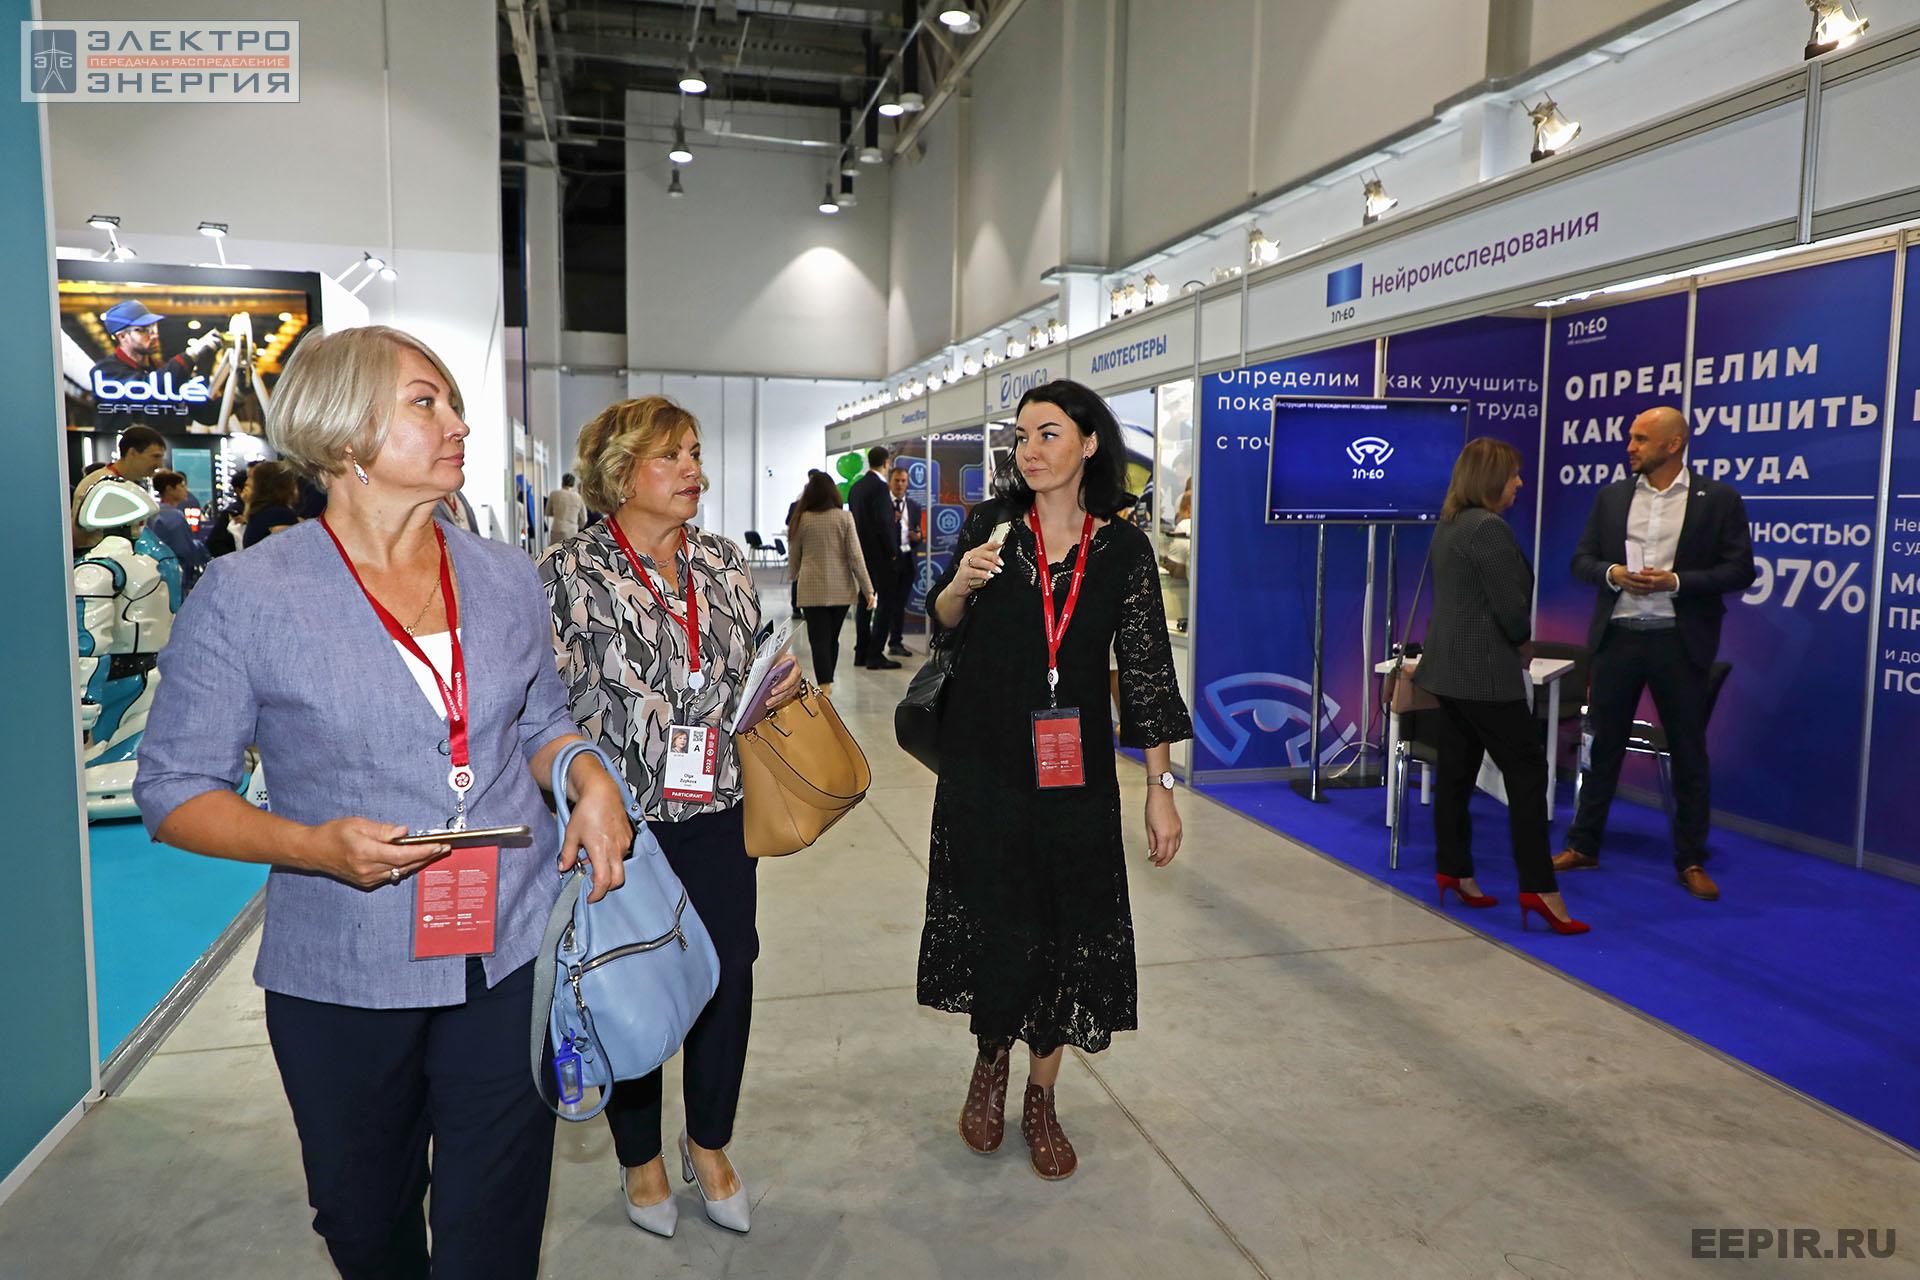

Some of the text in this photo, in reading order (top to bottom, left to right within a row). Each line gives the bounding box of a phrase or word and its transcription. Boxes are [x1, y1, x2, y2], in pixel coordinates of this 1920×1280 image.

[1371, 211, 1600, 298] Нейроисследования
[1091, 333, 1167, 374] АЛКОТЕСТЕРЫ
[1218, 370, 1539, 394] Определим как улучшить
[1564, 343, 1819, 401] ОПРЕДЕЛИМ
[94, 369, 209, 402] bollé
[97, 403, 189, 416] SAFETY
[1218, 396, 1539, 420] пока труда
[1562, 415, 1625, 445] КАК
[1694, 395, 1878, 436] УЧШИТЬ
[1216, 436, 1272, 450] с точ
[1559, 455, 1810, 485] ОХРА ТРУДА
[1748, 521, 1872, 546] НОСТЬЮ
[1894, 518, 1920, 532] Не
[1892, 541, 1902, 553] с
[1741, 556, 1866, 614] 97%
[1899, 650, 1920, 664] до
[671, 791, 704, 799] PARTICIPANT
